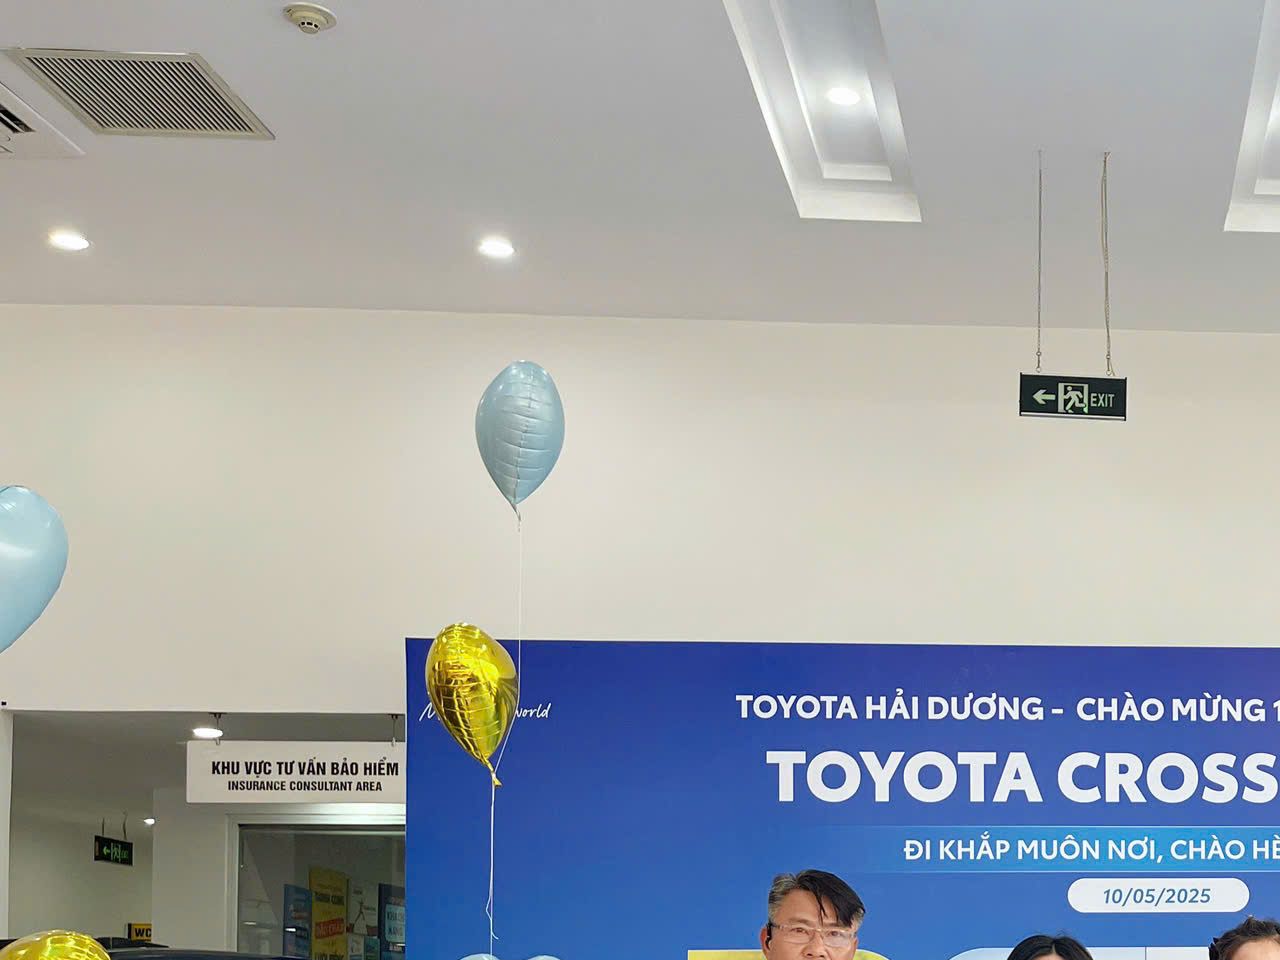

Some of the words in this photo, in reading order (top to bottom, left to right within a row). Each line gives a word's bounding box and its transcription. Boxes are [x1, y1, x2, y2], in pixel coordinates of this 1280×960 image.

[1090, 393, 1115, 407] EXIT
[735, 695, 858, 720] TOYOTA
[865, 688, 919, 720] HẢI
[927, 692, 1044, 721] DƯƠNG
[1076, 691, 1165, 721] CHÀO
[1172, 692, 1266, 722] MỪNG
[212, 761, 240, 776] KHU
[244, 760, 272, 778] VỰC
[276, 760, 295, 776] TƯ
[297, 757, 326, 776] VẤN
[331, 757, 359, 776] BẢO
[363, 757, 399, 776] HIỂM
[766, 750, 1043, 803] TOYOTA
[1057, 751, 1279, 804] CROSS
[228, 781, 286, 791] INSURANCE
[290, 781, 353, 791] CONSULTANT
[355, 781, 383, 792] AREA
[903, 839, 931, 860] ĐI
[939, 831, 1010, 860] KHẮP
[1017, 834, 1100, 860] MUÔN
[1108, 836, 1163, 863] NƠI,
[1170, 834, 1245, 860] CHÀO
[1103, 888, 1211, 907] 10/05/2025
[134, 927, 152, 938] WC
